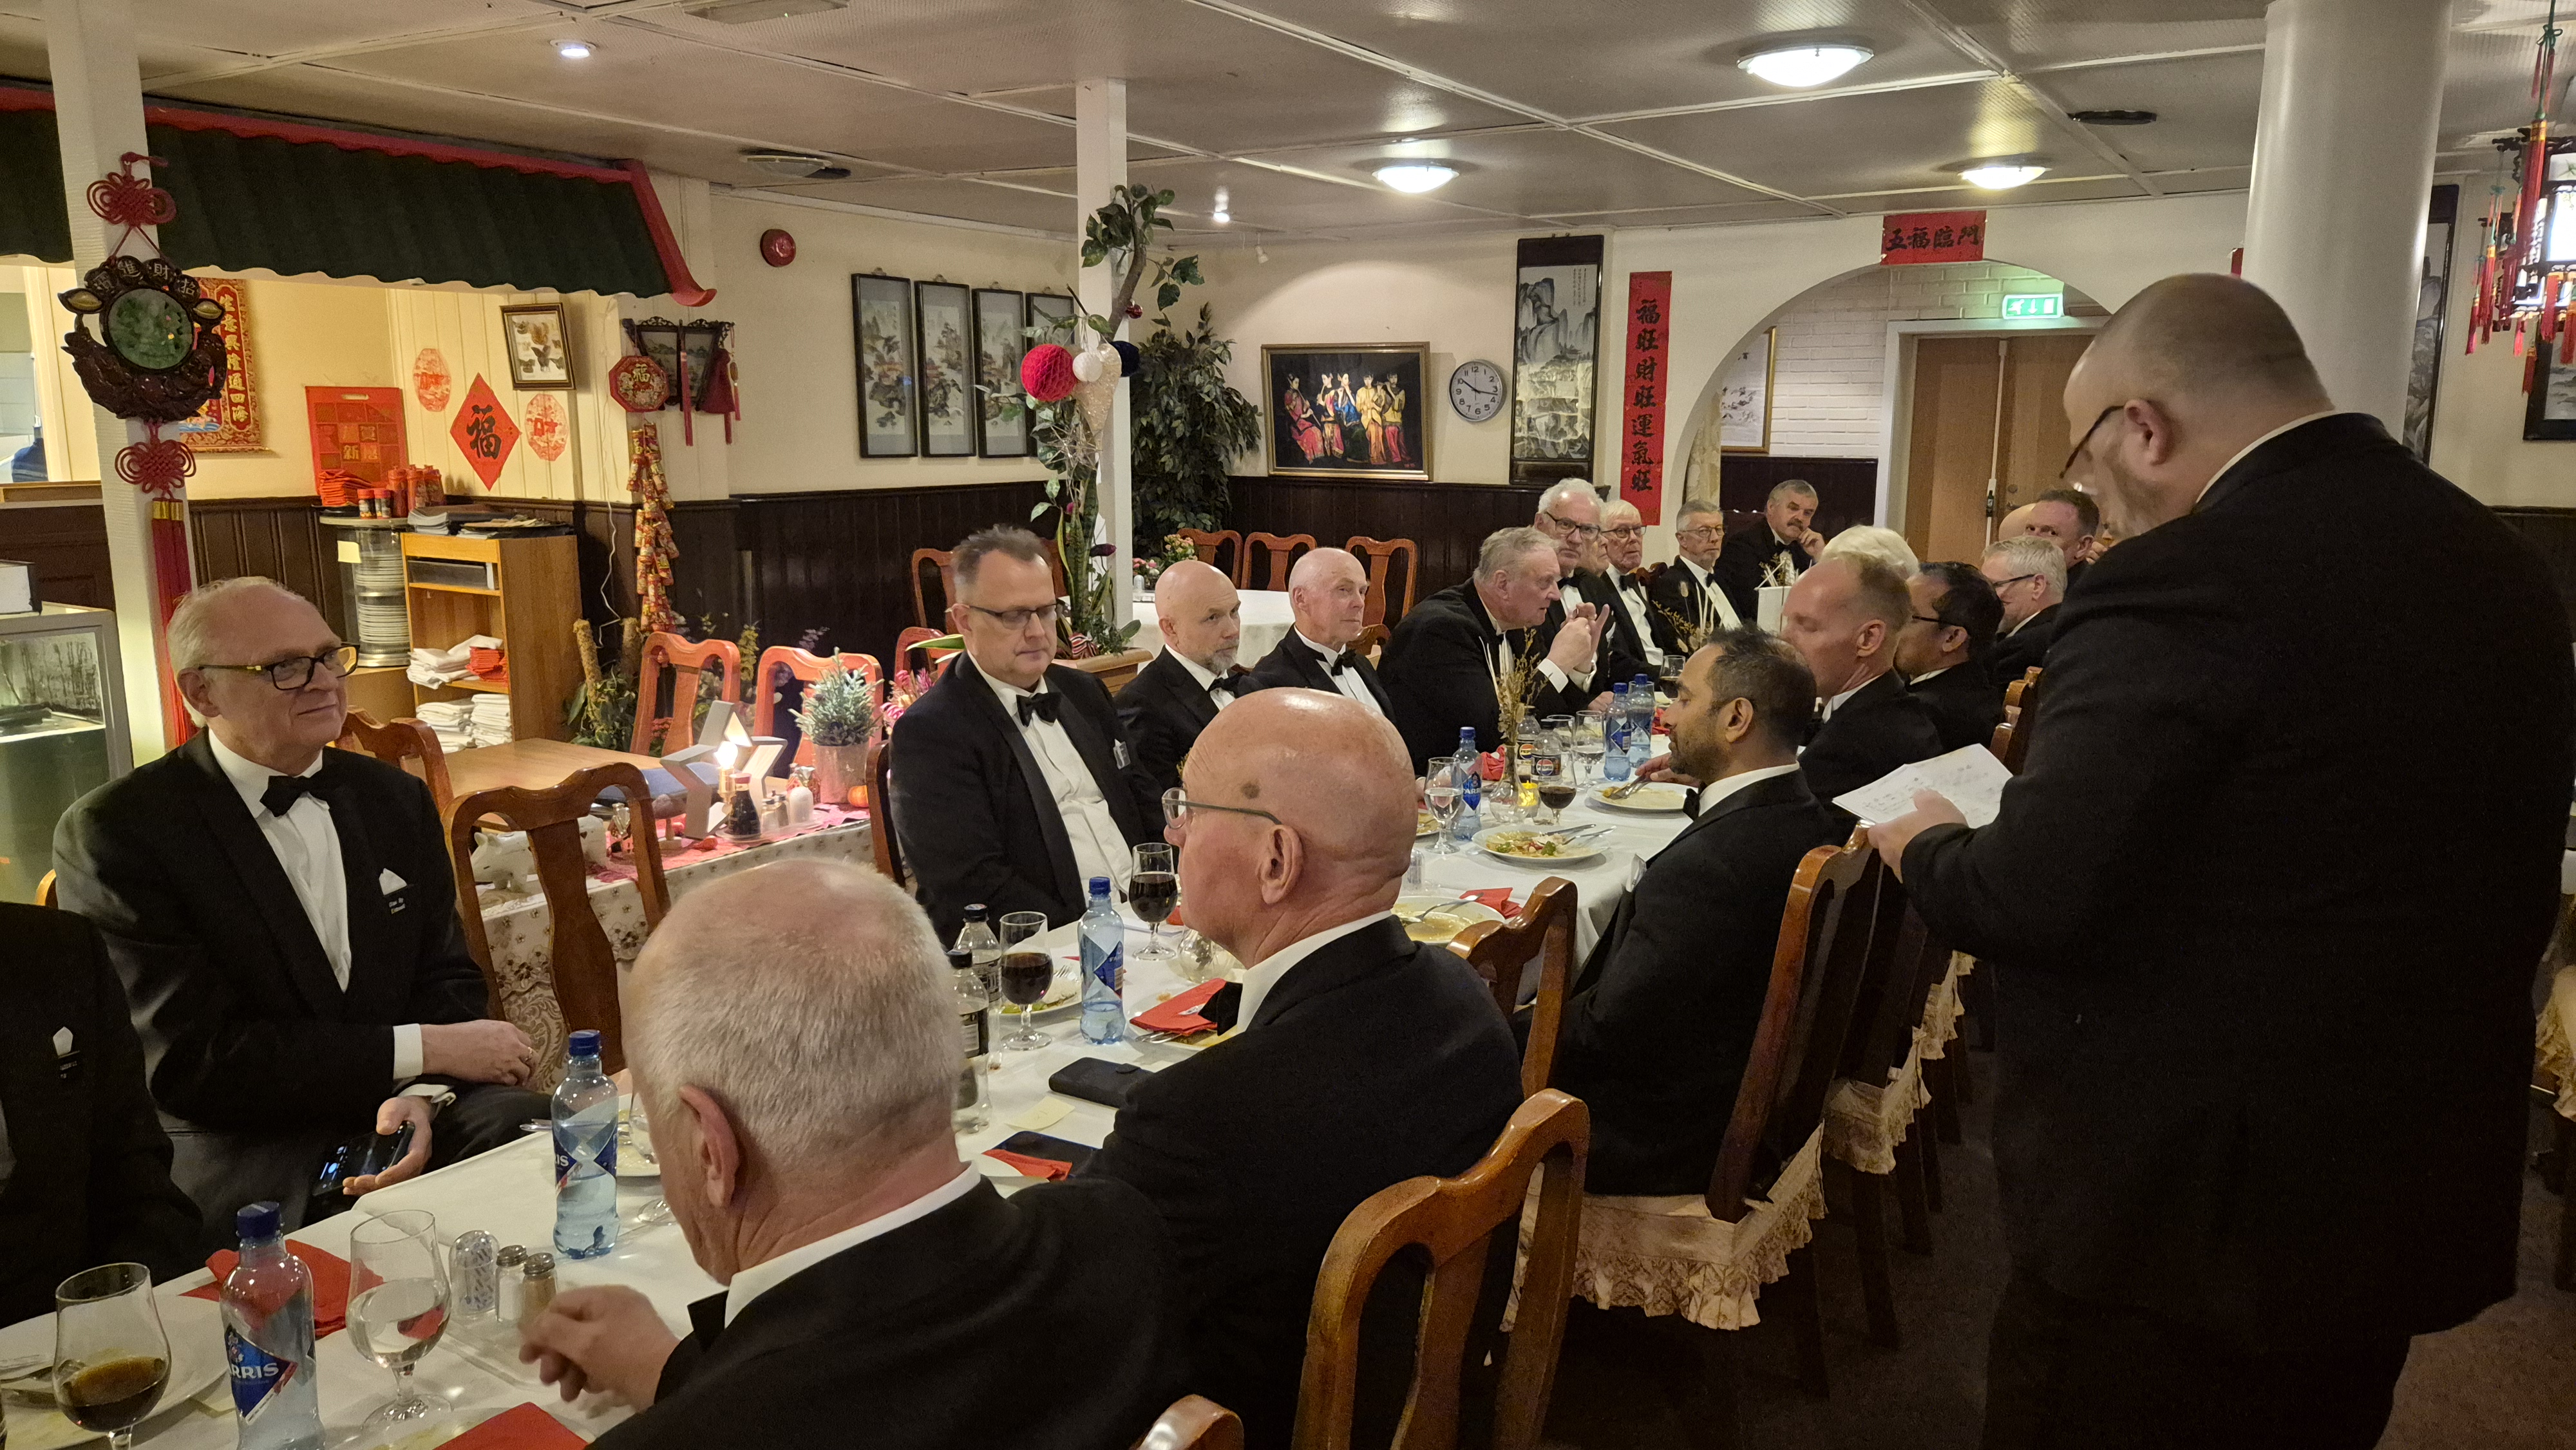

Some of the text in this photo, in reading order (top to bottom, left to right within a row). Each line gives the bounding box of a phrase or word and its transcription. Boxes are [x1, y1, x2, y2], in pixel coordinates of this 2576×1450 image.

[1886, 225, 1980, 251] 五福臨門
[1631, 298, 1661, 492] 福旺財旺運氣旺
[466, 404, 502, 460] 福
